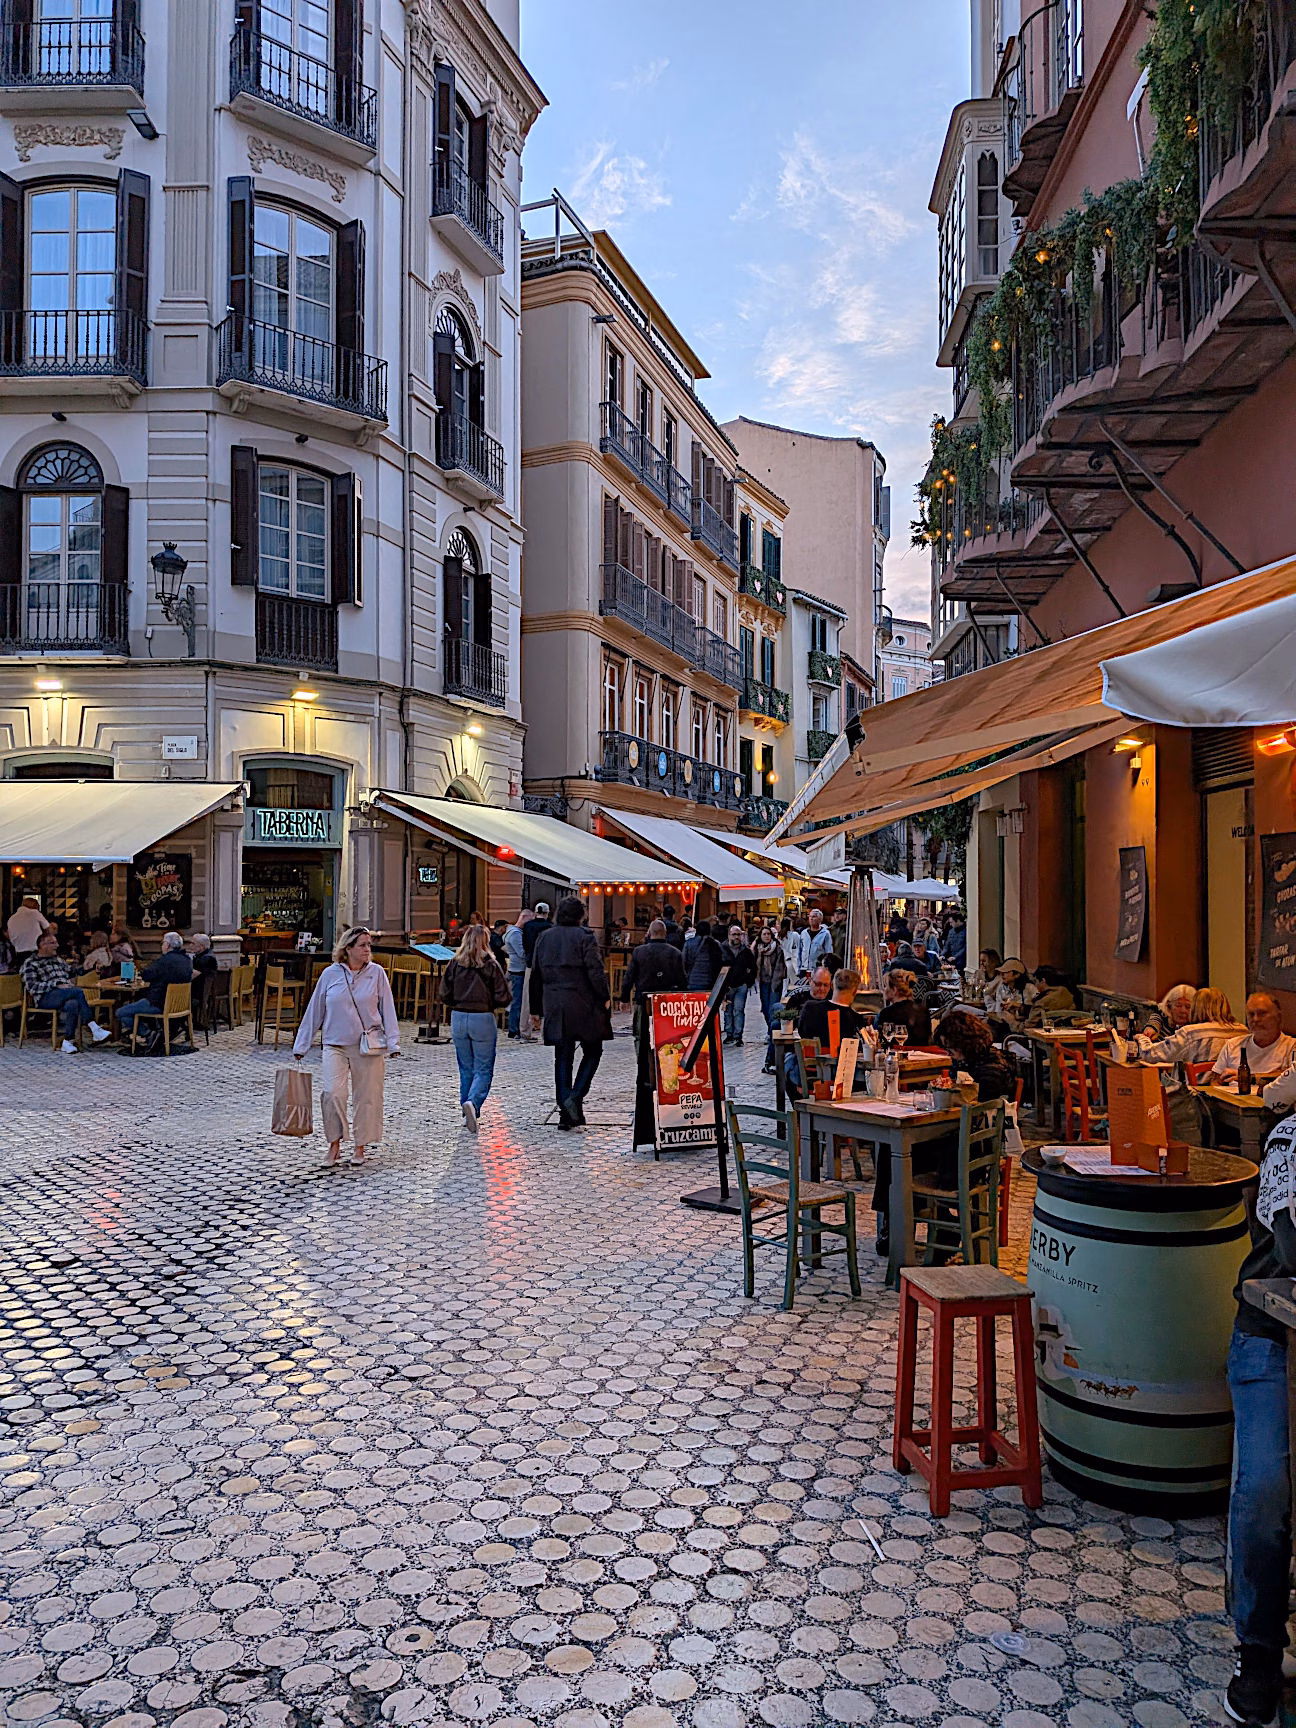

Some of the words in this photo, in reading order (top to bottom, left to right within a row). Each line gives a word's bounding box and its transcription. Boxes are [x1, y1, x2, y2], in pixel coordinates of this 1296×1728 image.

[257, 808, 327, 839] TABERNA
[151, 884, 178, 902] COPAS
[660, 1000, 706, 1016] COCKTAI
[680, 1094, 703, 1104] PEPA
[1030, 1228, 1077, 1267] ERBY
[1067, 1277, 1099, 1294] SPRITZ
